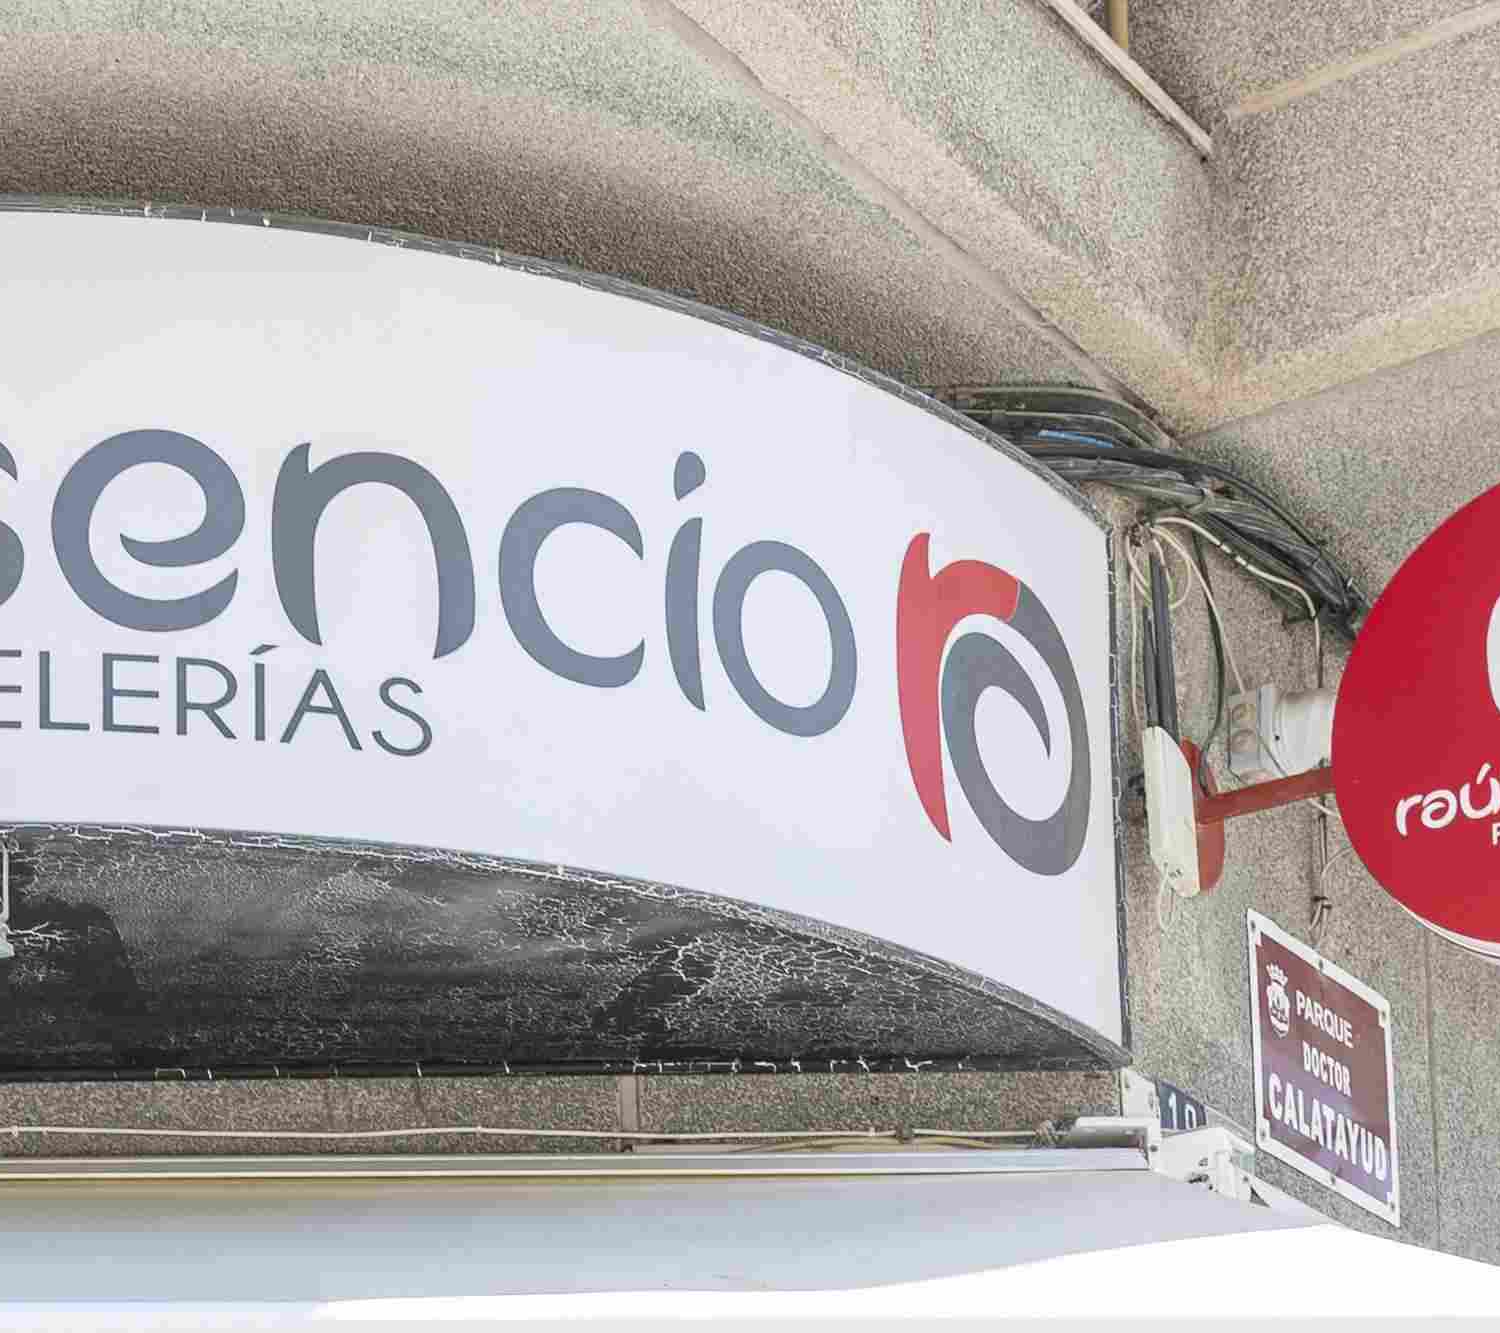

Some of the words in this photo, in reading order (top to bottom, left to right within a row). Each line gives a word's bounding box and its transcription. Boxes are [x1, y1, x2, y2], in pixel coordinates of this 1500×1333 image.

[1295, 989, 1354, 1049] PARQUE
[1302, 1040, 1353, 1098] DOCTOR
[1268, 1072, 1388, 1181] CALATAYUD
